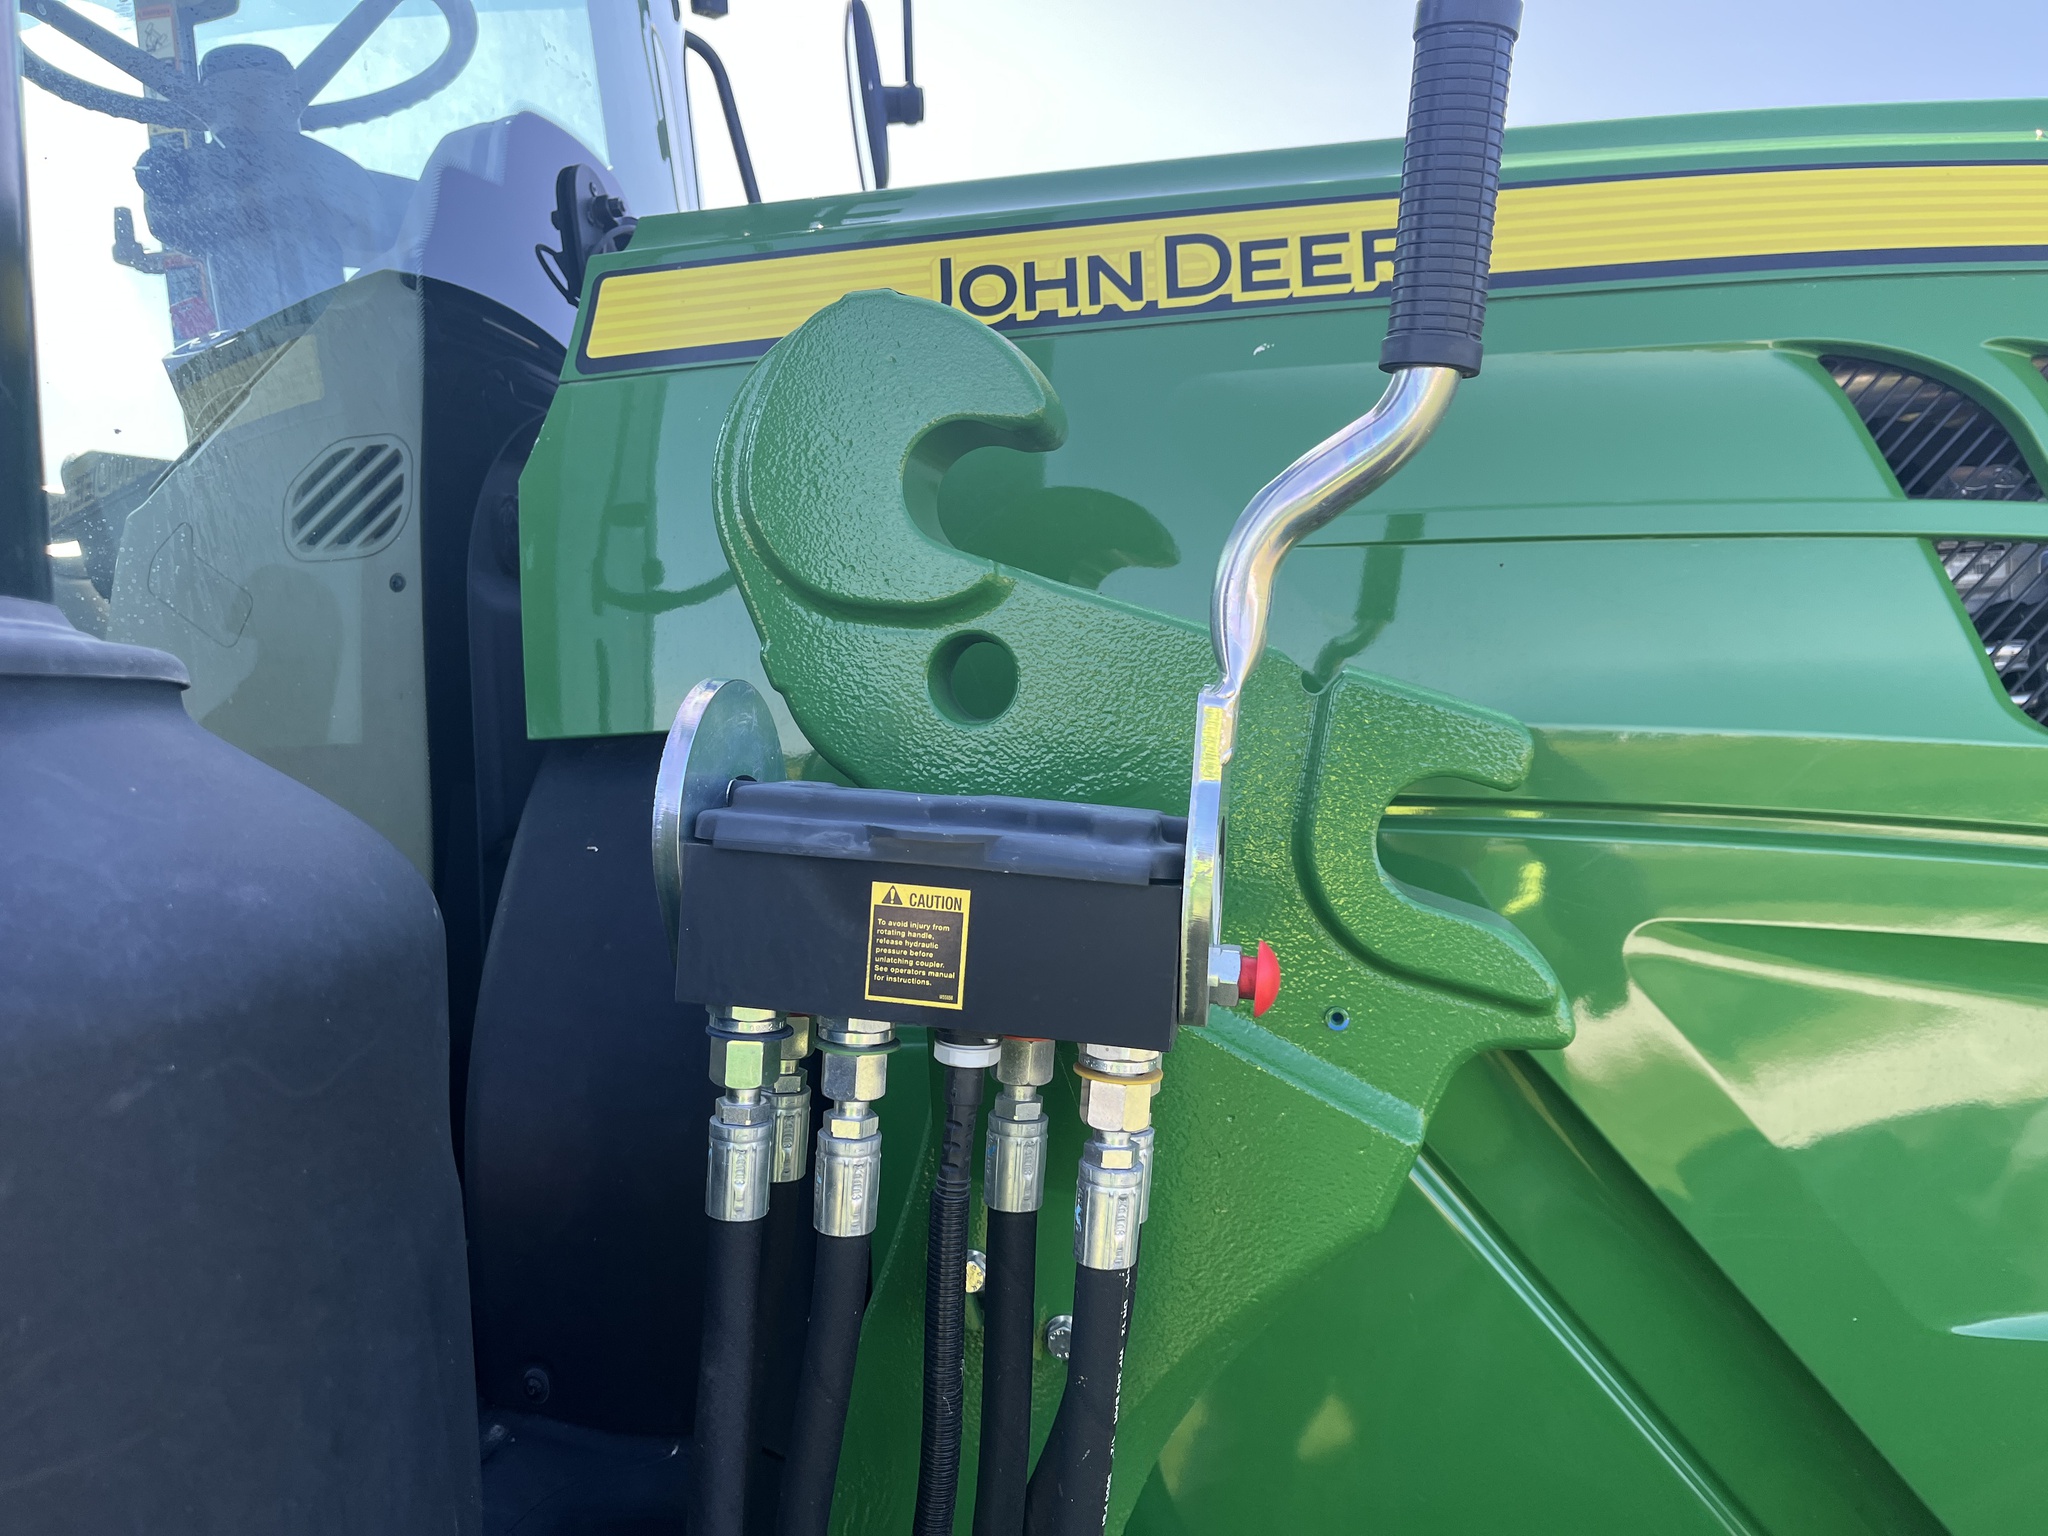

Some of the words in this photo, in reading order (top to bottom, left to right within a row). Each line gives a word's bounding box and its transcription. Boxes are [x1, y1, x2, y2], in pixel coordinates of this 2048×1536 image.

[940, 250, 1144, 313] JOHN
[1164, 228, 1398, 299] DEER
[909, 892, 962, 911] CAUTION
[877, 918, 886, 926] To
[888, 920, 909, 928] avoid
[910, 922, 931, 931] injury
[932, 923, 950, 932] from
[876, 929, 906, 938] rotating
[907, 931, 935, 940] handle,
[876, 938, 903, 946] release
[905, 939, 939, 949] hydraulic
[875, 948, 908, 956] pressure
[909, 949, 934, 958] before
[874, 956, 914, 966] unlatching
[915, 959, 945, 969] coupler.
[874, 964, 889, 972] See
[890, 967, 926, 976] operators
[928, 970, 955, 979] manual
[873, 973, 885, 981] for
[886, 975, 932, 986] instructions.
